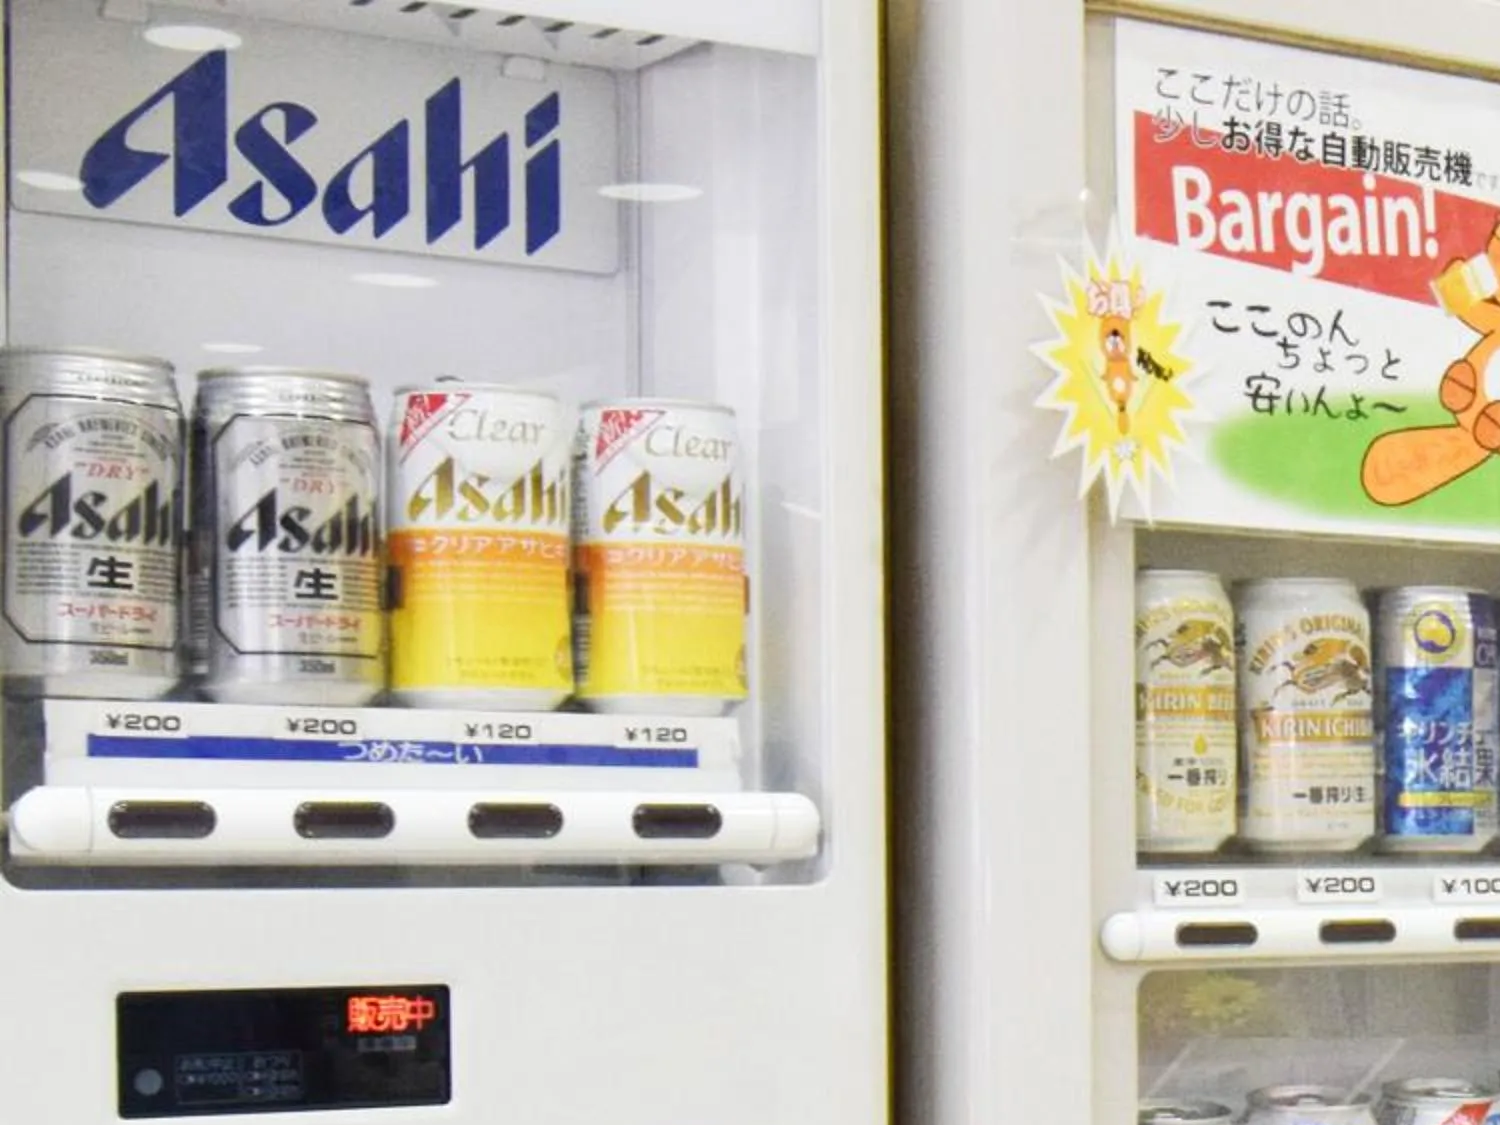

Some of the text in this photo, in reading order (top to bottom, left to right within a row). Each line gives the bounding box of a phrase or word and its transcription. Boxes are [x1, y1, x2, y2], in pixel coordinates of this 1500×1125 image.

[1154, 67, 1364, 130] ここだけの話。
[80, 48, 562, 256] Asahi
[1171, 164, 1439, 278] Bargain!
[1206, 300, 1360, 346] ここのん
[1276, 336, 1401, 379] ちょっと
[449, 407, 545, 443] Clear
[646, 425, 733, 459] Clear
[87, 556, 134, 590] 生
[294, 567, 339, 601] 生
[106, 713, 181, 733] ¥200
[286, 717, 357, 736] ¥200
[463, 721, 532, 741] ¥120
[625, 725, 688, 744] ¥120
[1163, 878, 1239, 898] ¥200
[1306, 875, 1376, 895] ¥200
[347, 995, 435, 1032] 販売中
